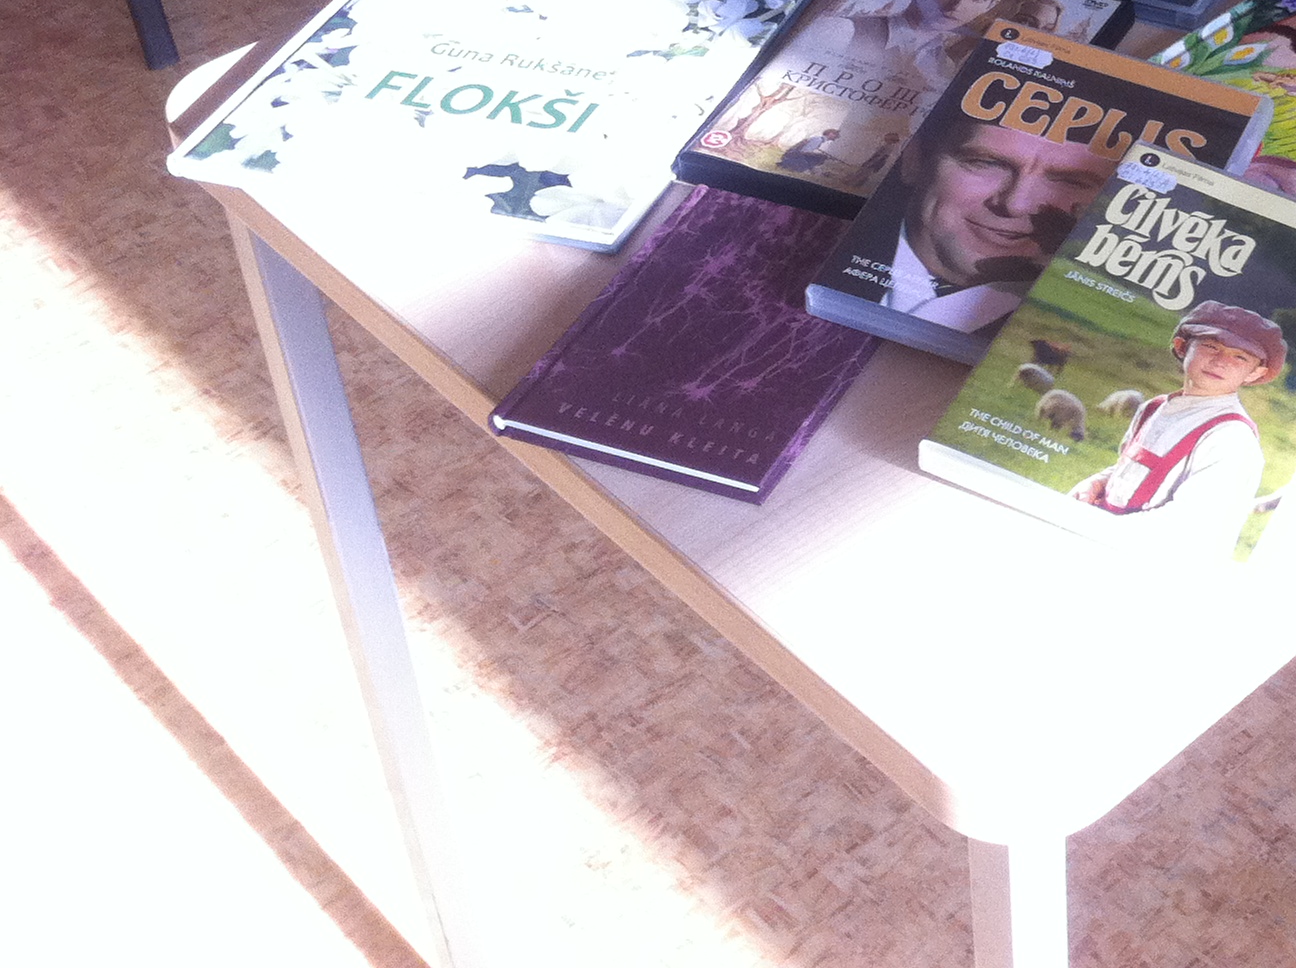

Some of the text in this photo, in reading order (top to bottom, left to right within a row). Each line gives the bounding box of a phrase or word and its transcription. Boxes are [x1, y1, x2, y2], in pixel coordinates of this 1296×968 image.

[988, 56, 1034, 76] ROLANDS
[364, 70, 600, 134] FLOKŠI
[961, 71, 1208, 162] CEPLIS
[1105, 183, 1257, 277] Cilvēka
[842, 267, 878, 284] АФЕРА
[851, 255, 871, 268] THE
[1065, 270, 1096, 289] JĀNIS
[669, 433, 762, 466] KLEITA
[958, 421, 1050, 463] ДИТЯ ЧЕЛОВЕКА
[969, 408, 1070, 455] THE CHILD OF MAN
